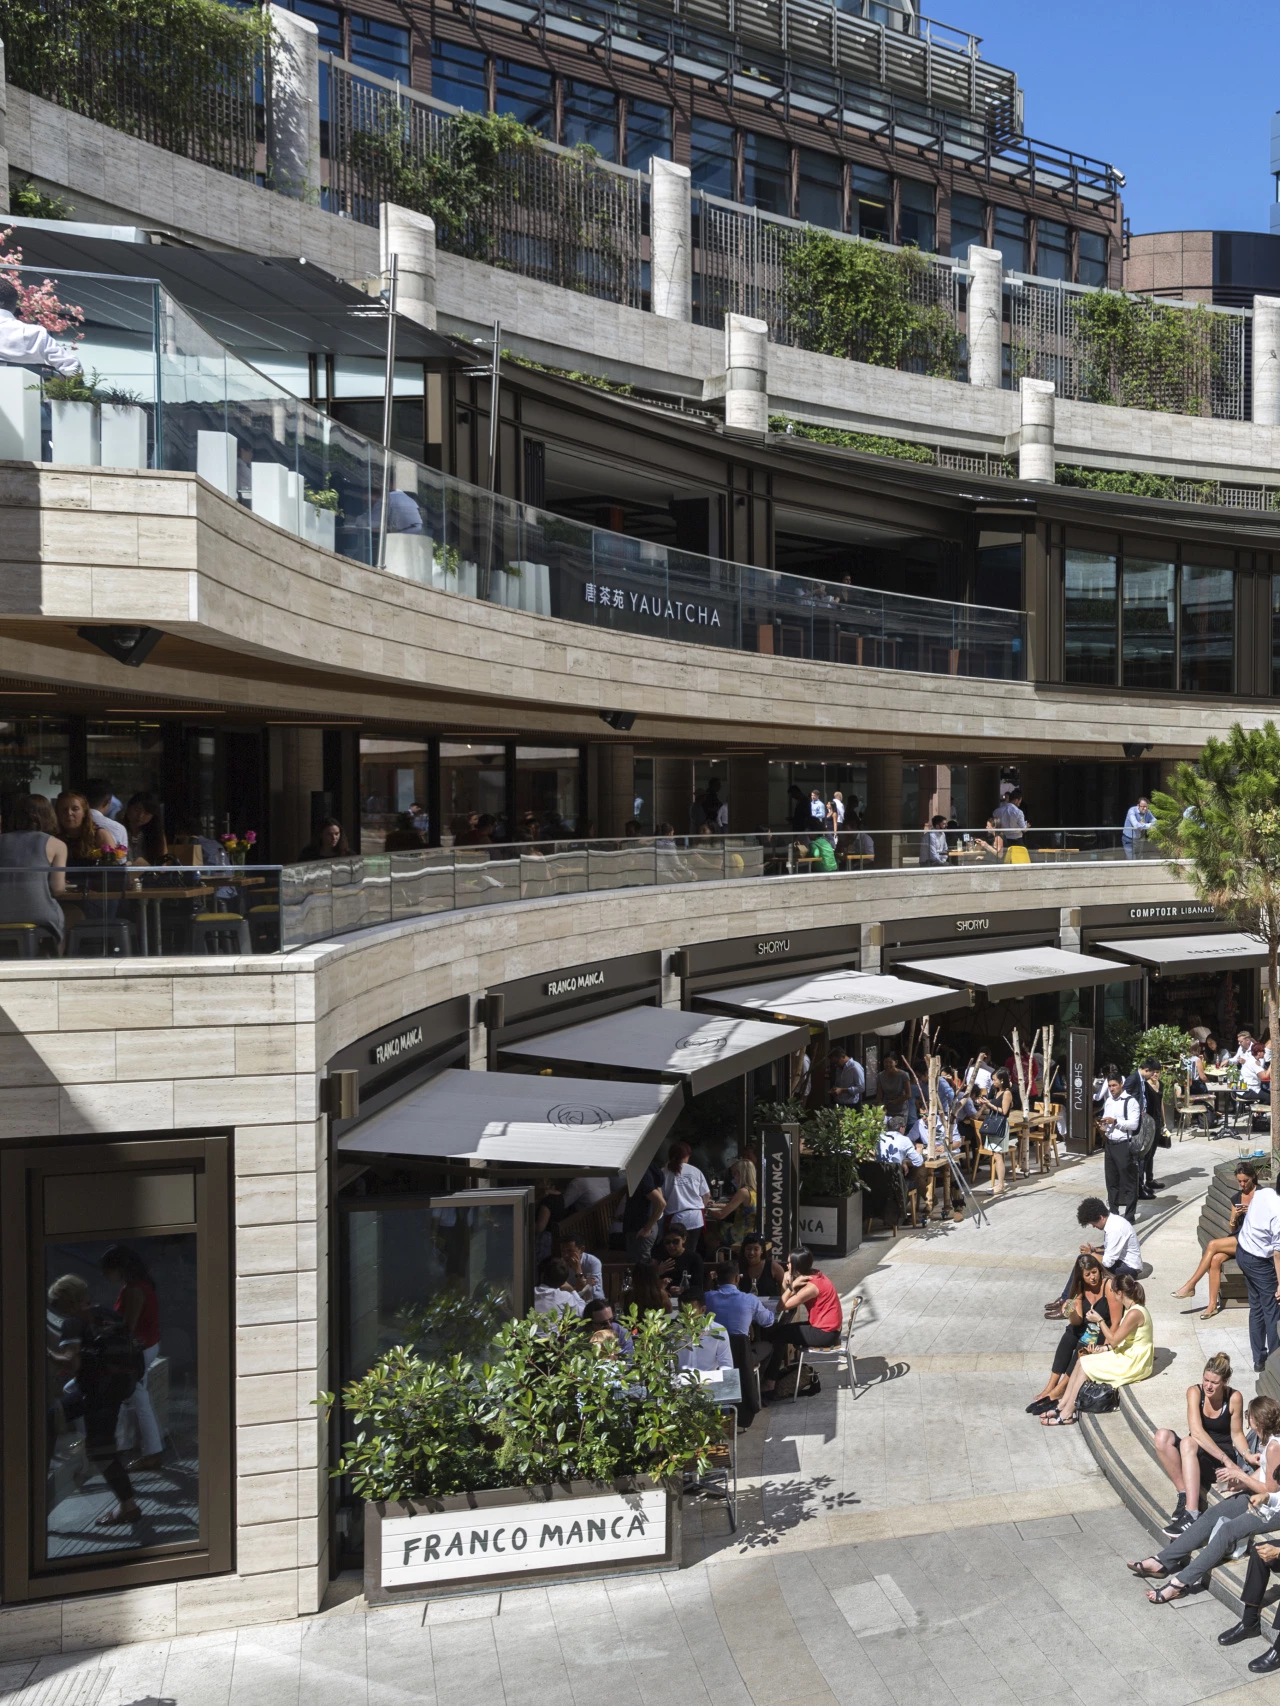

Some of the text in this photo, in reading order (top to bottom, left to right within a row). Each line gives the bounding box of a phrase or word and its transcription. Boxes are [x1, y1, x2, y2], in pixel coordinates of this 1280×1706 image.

[585, 582, 721, 627] 唐茶苑 YAUATCHA
[956, 918, 989, 931] SHORYU
[1130, 905, 1215, 918] COMPTOIR LIBANAIS
[757, 938, 790, 955] SHORYU
[548, 970, 605, 996] FRANCO MANCA
[375, 1025, 423, 1065] FRANCO MANCA
[1073, 1062, 1084, 1110] SHORYU
[771, 1151, 784, 1263] FRANCO MANCA
[402, 1513, 646, 1566] FRANCO MANCA
